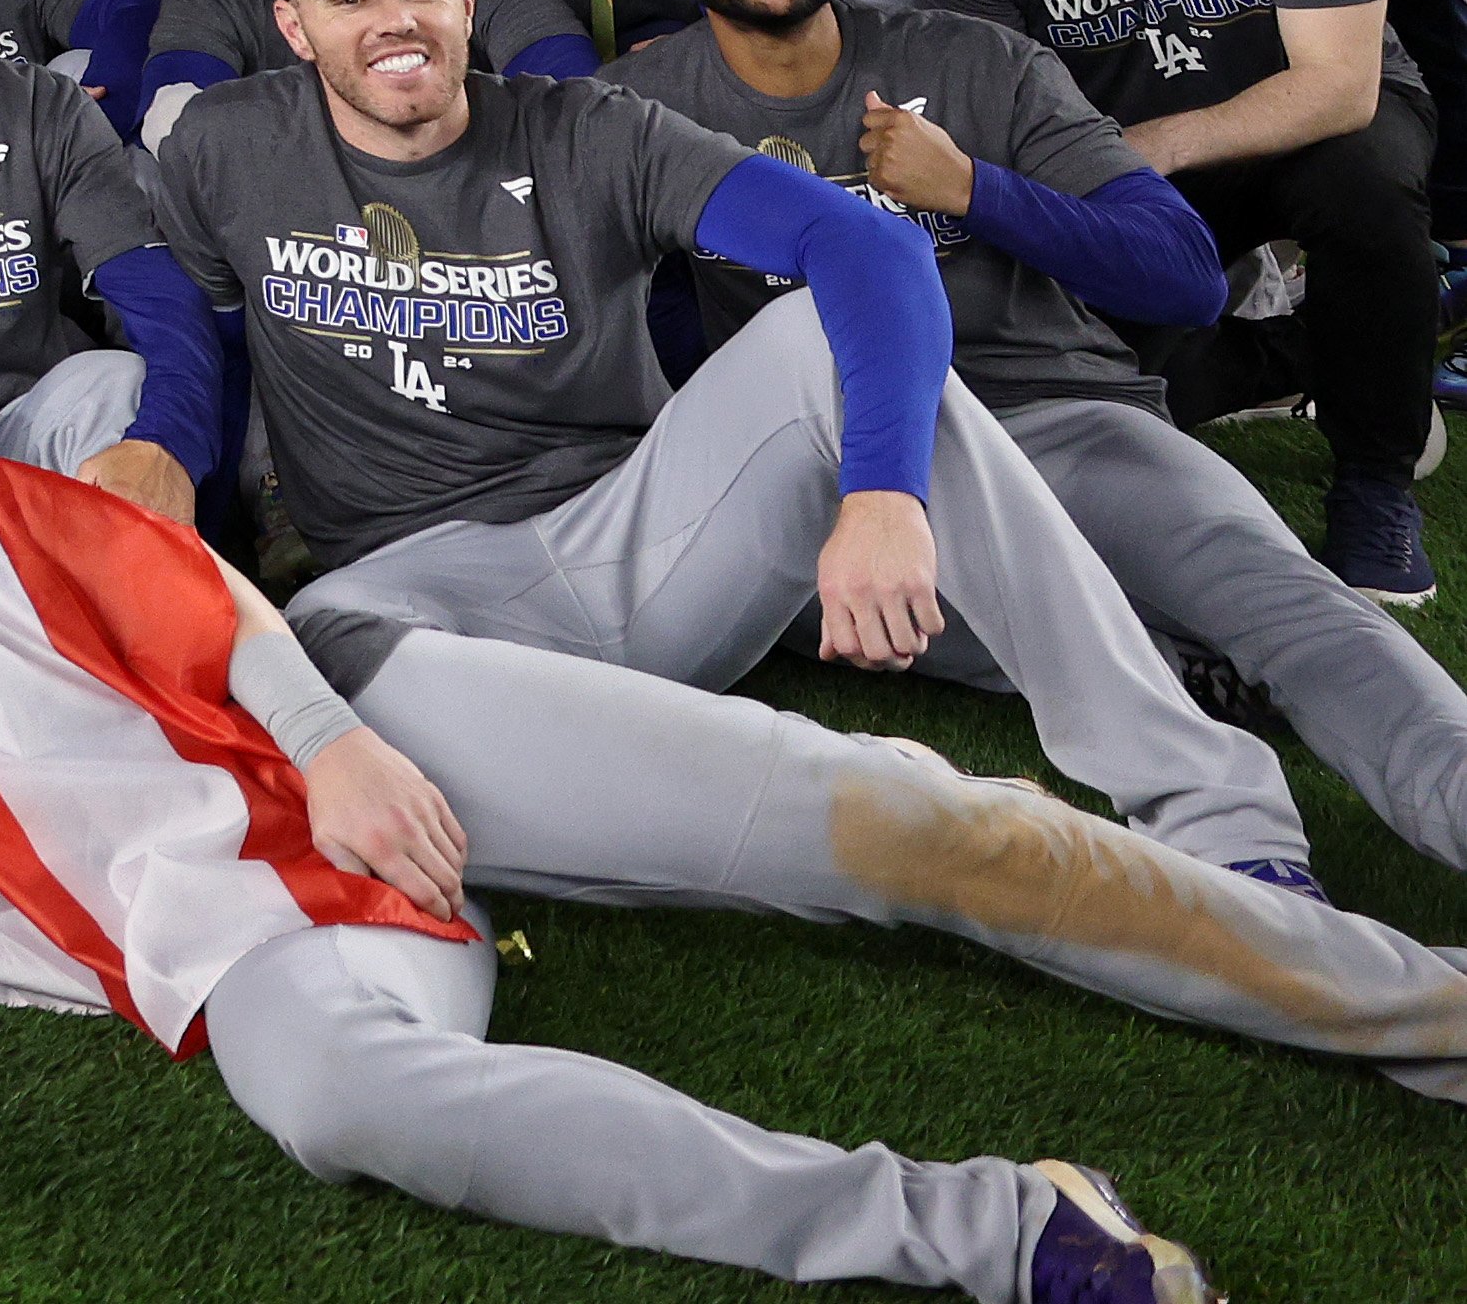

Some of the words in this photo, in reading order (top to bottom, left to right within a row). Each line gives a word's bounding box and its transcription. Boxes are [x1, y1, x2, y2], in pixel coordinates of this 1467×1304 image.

[264, 235, 419, 290] WORLD
[419, 258, 557, 302] SERIES
[261, 275, 568, 347] CHAMPIONS
[343, 343, 372, 361] 20
[444, 354, 472, 371] 24
